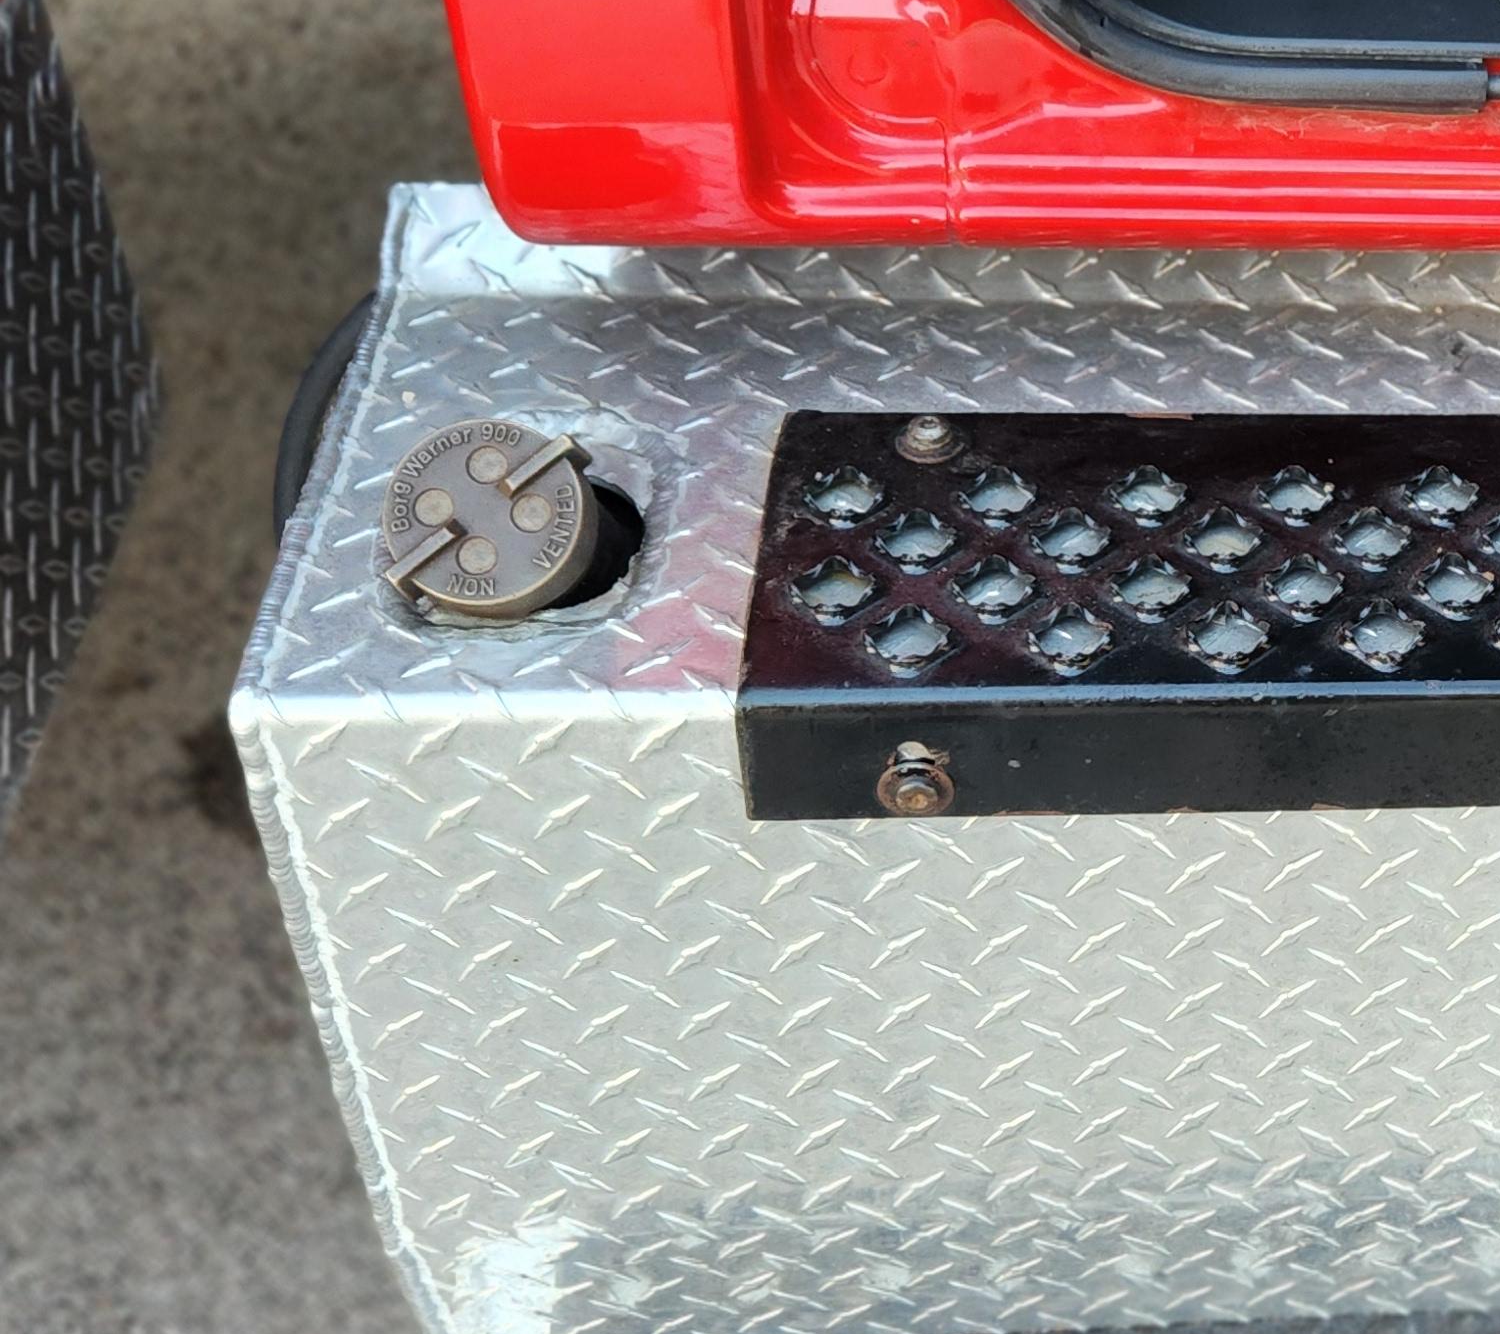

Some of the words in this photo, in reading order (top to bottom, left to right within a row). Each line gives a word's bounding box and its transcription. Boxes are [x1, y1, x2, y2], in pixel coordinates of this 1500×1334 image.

[401, 427, 473, 479] Warner
[480, 423, 521, 447] 900
[391, 482, 413, 533] Borg
[446, 573, 495, 596] NON
[532, 484, 575, 570] VENTED
